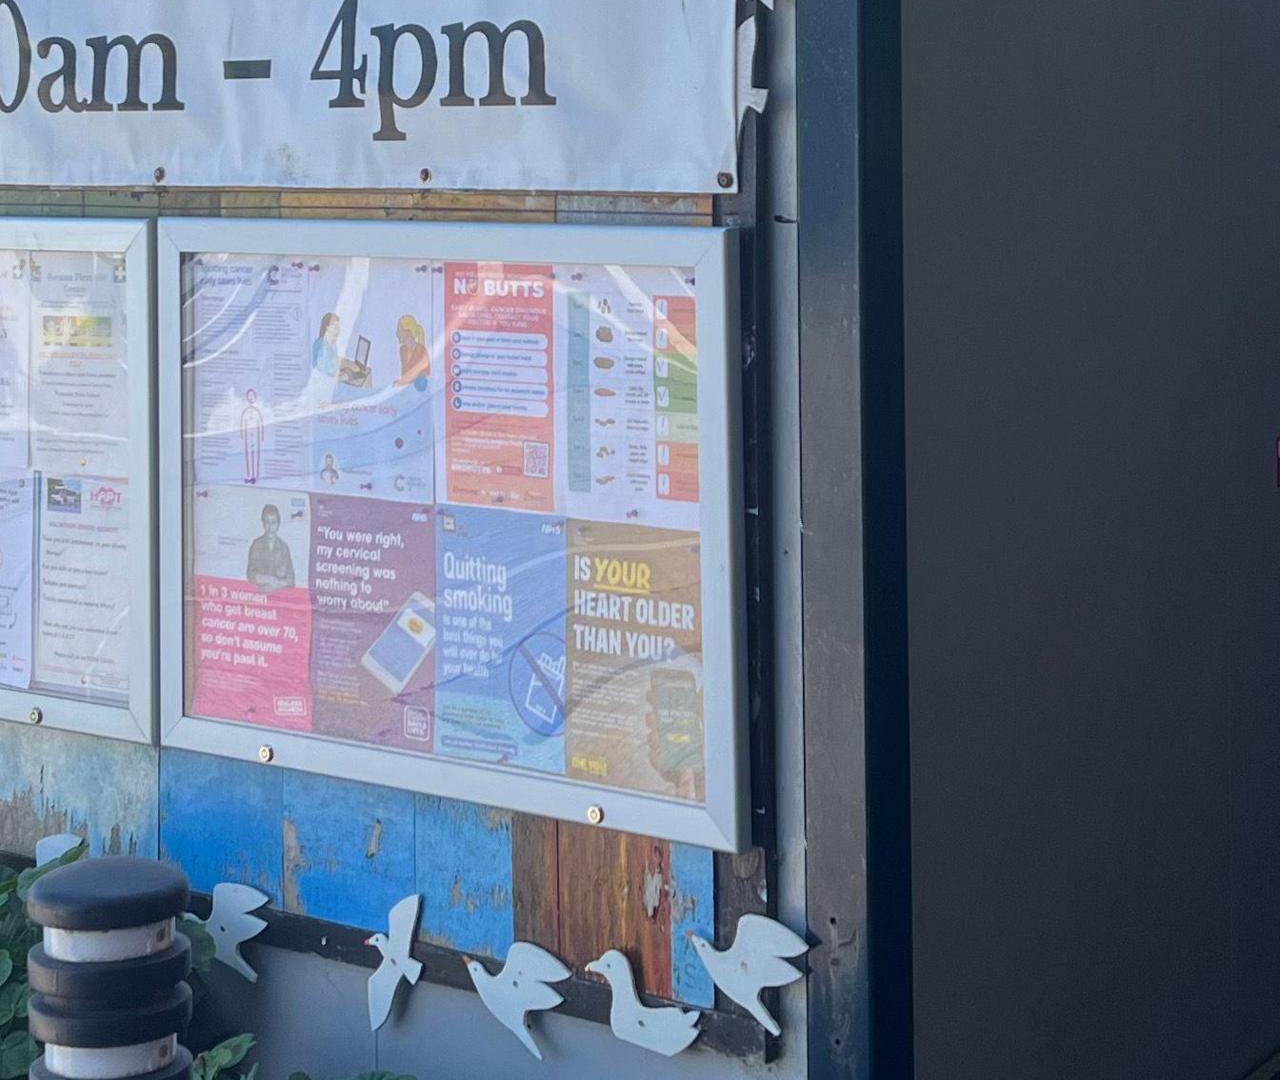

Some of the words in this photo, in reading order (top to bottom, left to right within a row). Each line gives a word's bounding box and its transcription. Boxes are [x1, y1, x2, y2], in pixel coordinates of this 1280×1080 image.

[484, 279, 545, 298] BUTTS
[346, 532, 372, 544] were
[375, 532, 405, 550] right,
[317, 546, 332, 558] my
[336, 547, 381, 561] cervical
[315, 561, 370, 580] screening
[373, 567, 397, 580] was
[443, 551, 508, 592] Quitting
[574, 554, 591, 581] IS
[593, 555, 651, 590] YOUR
[315, 577, 358, 596] nothing
[360, 581, 372, 594] to
[229, 591, 268, 603] women
[316, 596, 348, 611] worry
[443, 585, 513, 621] smoking
[201, 600, 223, 613] who
[224, 605, 241, 618] get
[244, 604, 278, 620] breast
[573, 588, 633, 624] HEART
[635, 598, 695, 631] OLDER
[201, 617, 236, 631] cancer
[237, 621, 255, 633] are
[257, 624, 280, 637] over
[242, 637, 283, 654] assume
[573, 623, 622, 656] THAN
[625, 630, 676, 663] YOU?
[233, 651, 256, 666] past
